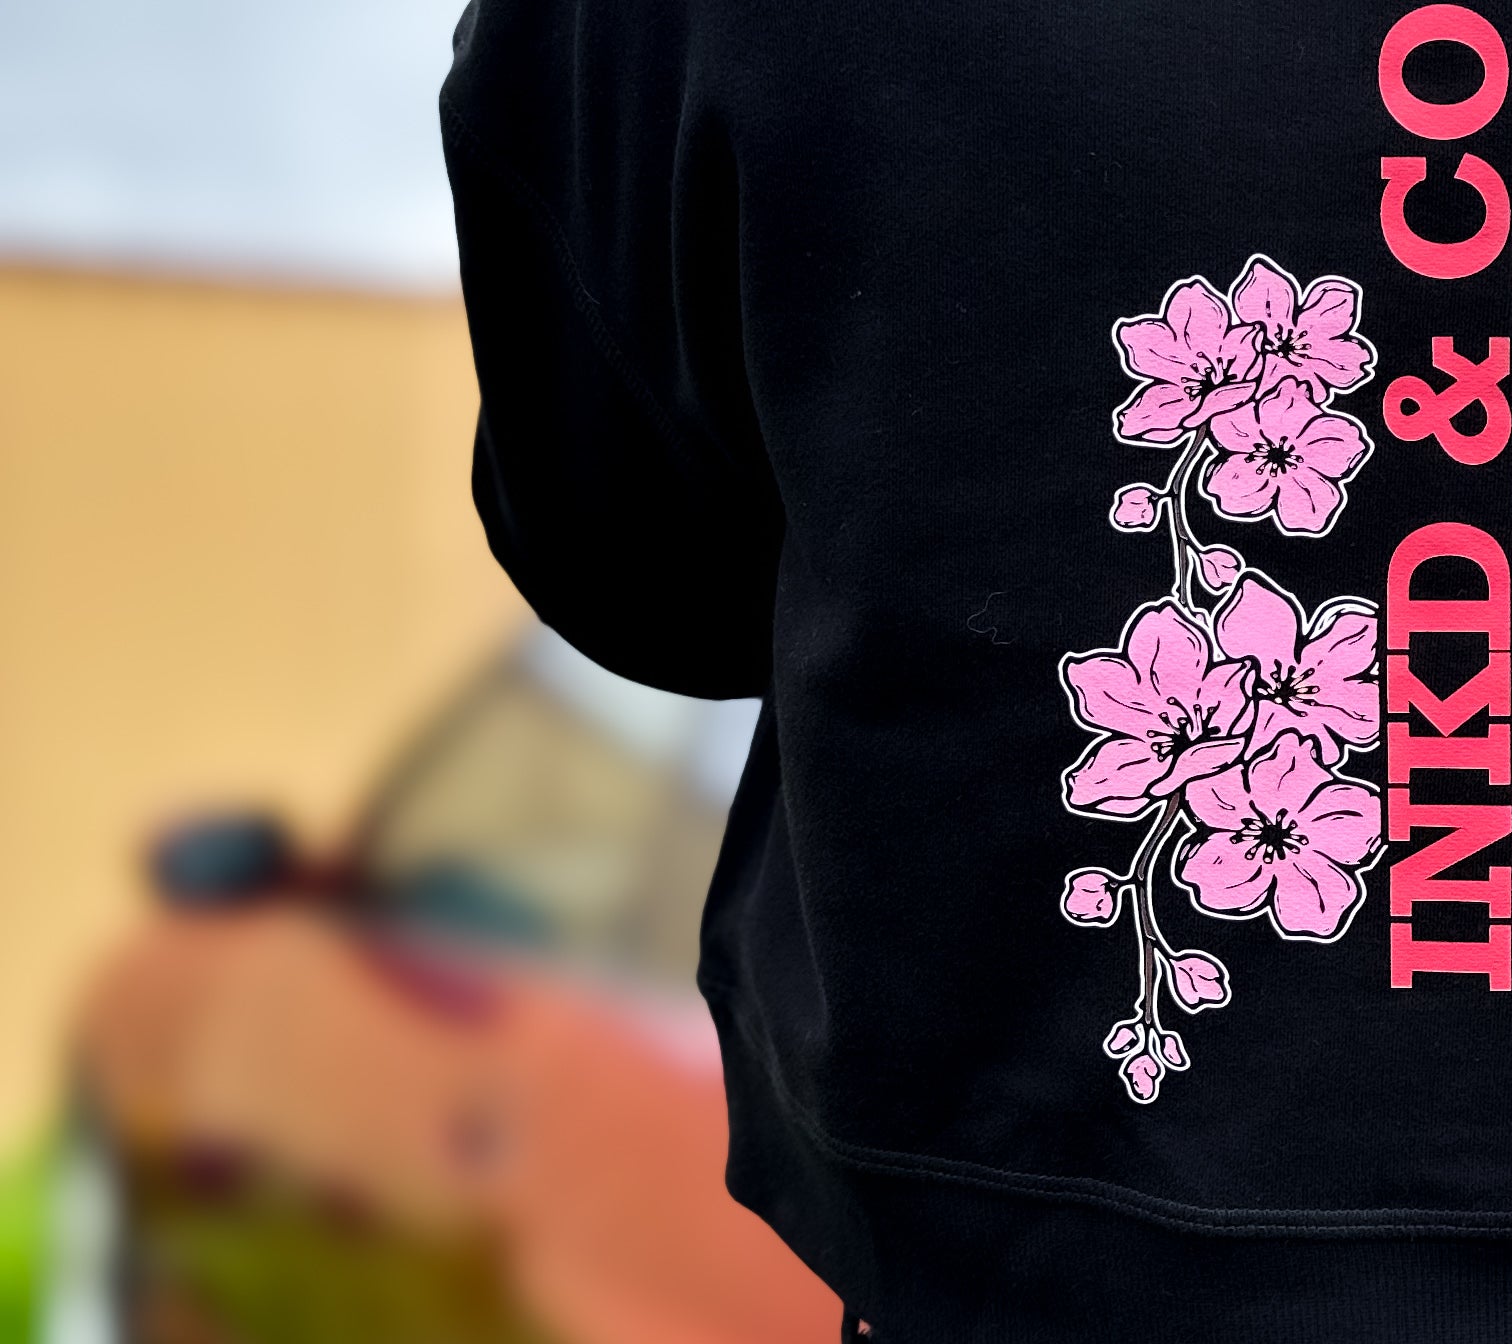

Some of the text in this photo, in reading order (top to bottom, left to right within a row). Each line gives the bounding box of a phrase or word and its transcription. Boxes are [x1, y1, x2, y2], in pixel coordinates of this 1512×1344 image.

[1378, 3, 1512, 991] INKD & CO
